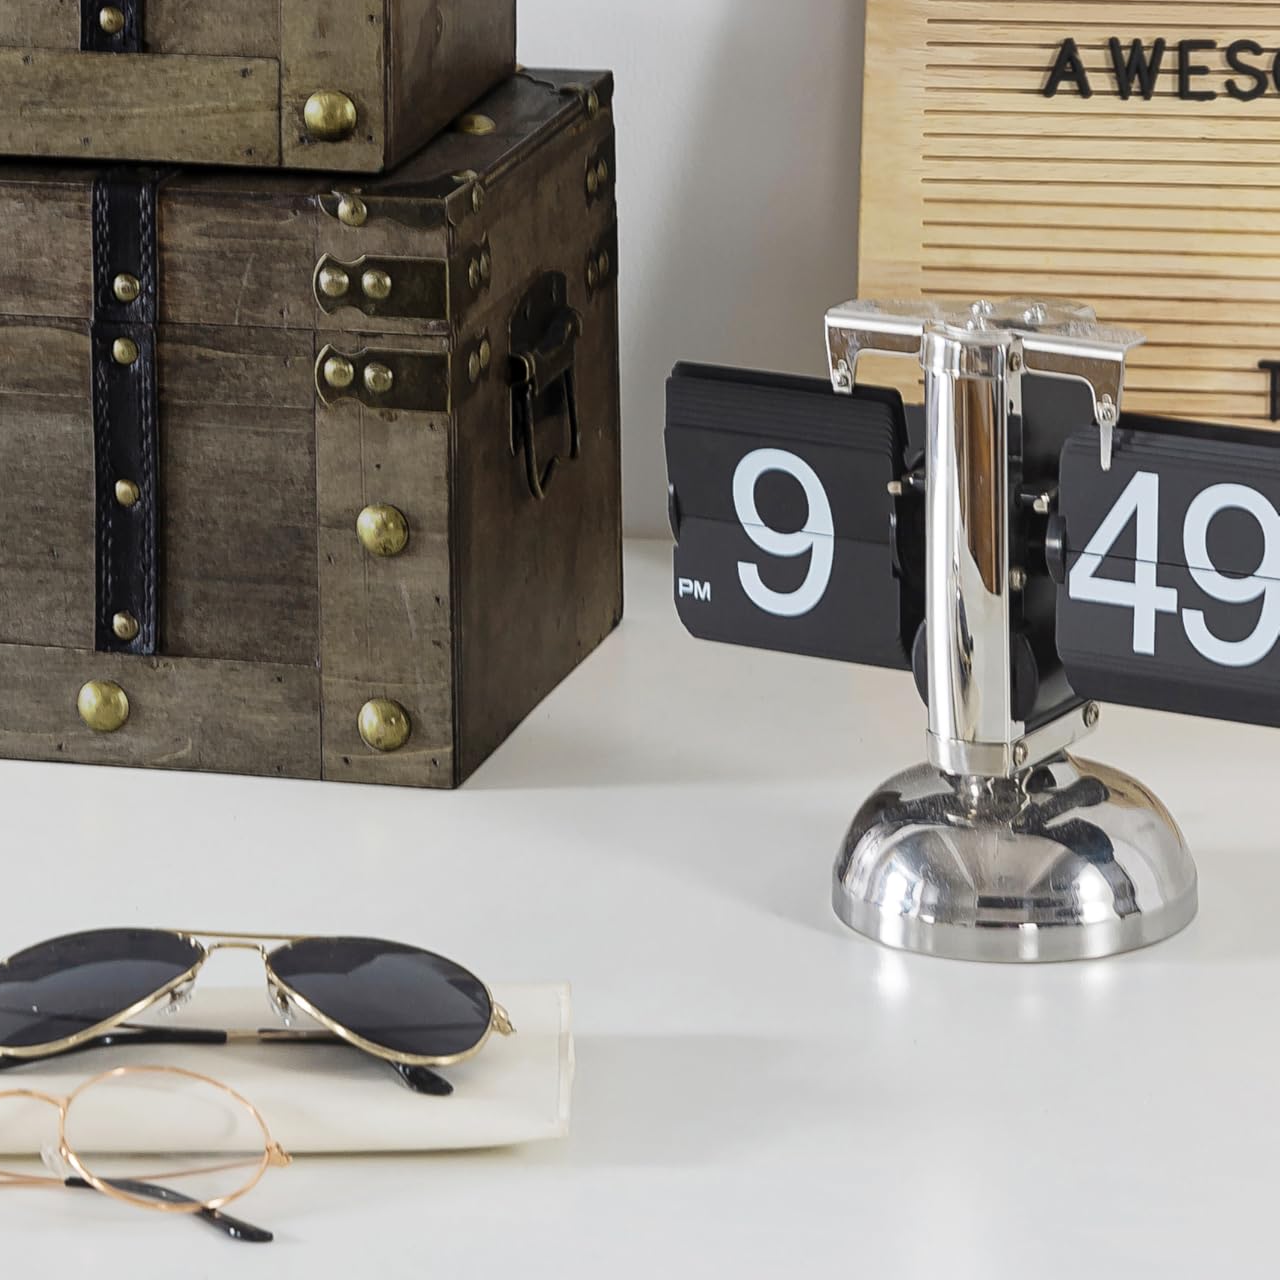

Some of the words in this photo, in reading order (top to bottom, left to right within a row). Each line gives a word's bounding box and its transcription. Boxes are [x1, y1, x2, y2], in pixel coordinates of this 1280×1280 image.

[1042, 37, 1280, 102] AWES
[678, 577, 711, 602] PM
[731, 447, 835, 617] 9
[1068, 470, 1280, 668] 49
